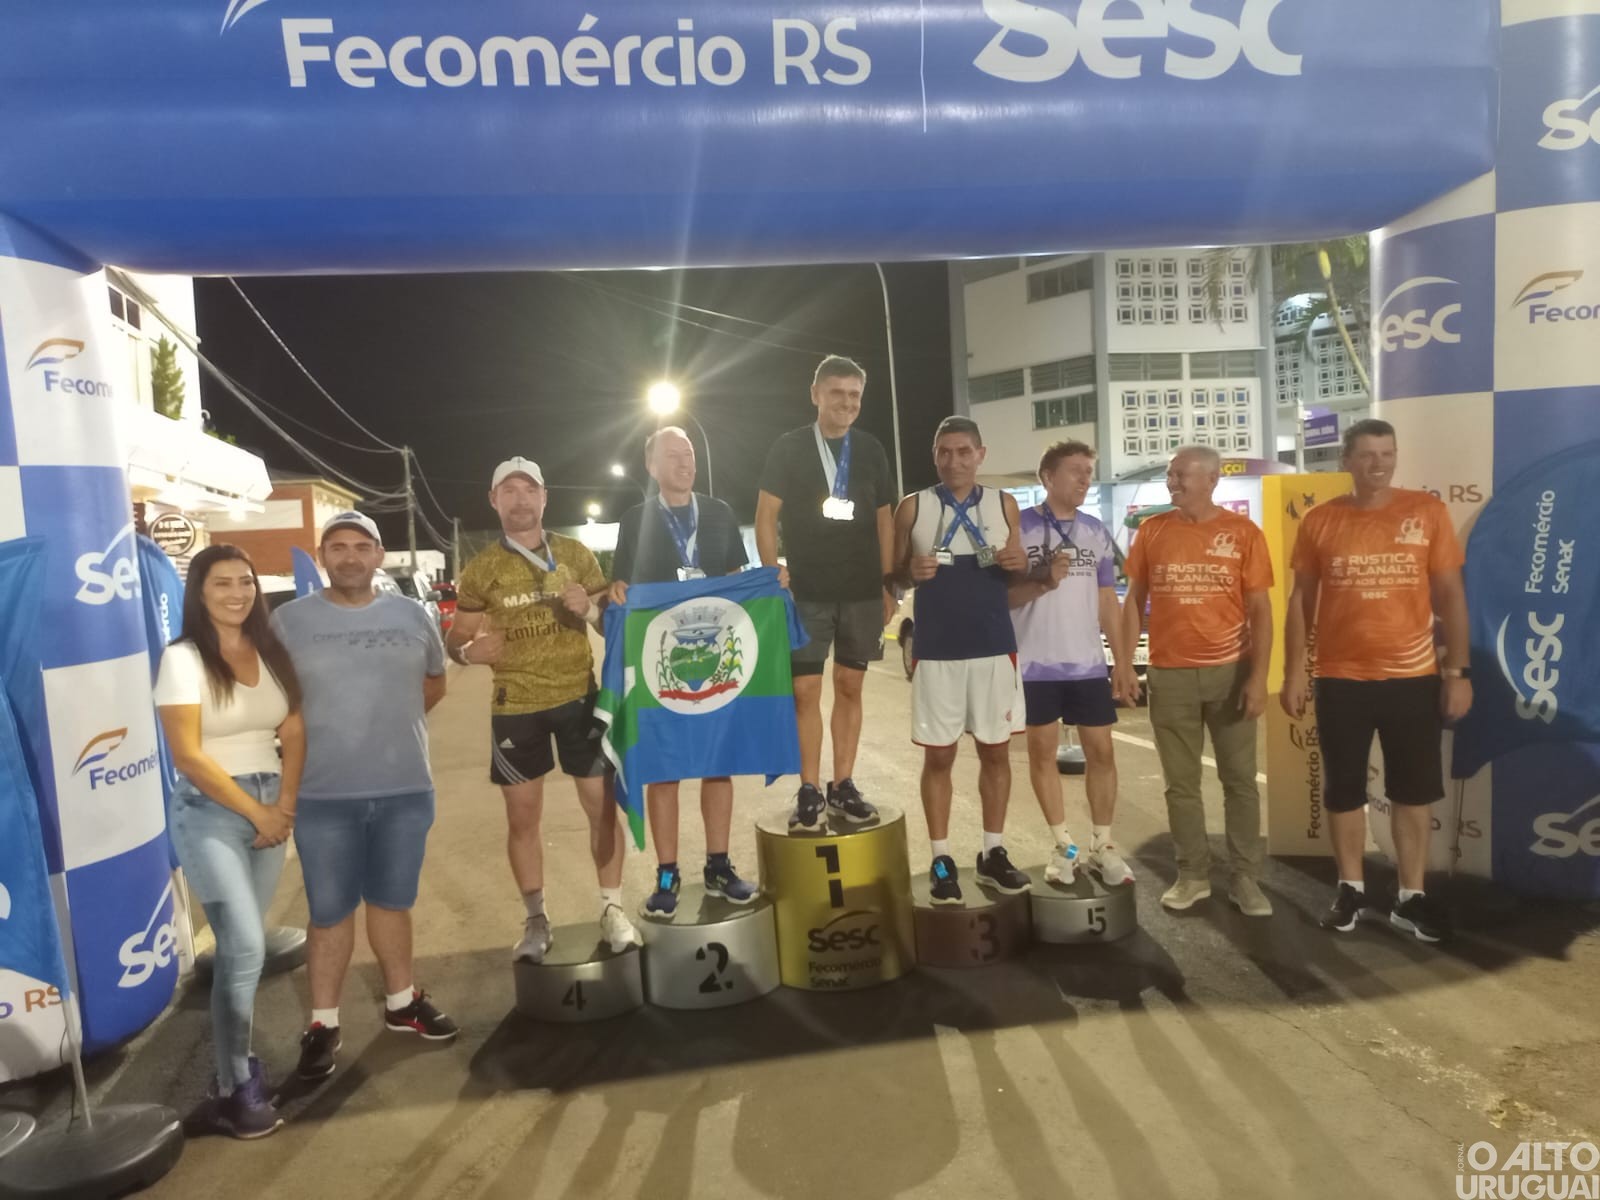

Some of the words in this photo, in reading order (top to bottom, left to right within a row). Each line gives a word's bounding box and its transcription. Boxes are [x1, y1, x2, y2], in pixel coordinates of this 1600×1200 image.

[280, 14, 746, 88] Fecomércio
[773, 15, 872, 86] RS
[1448, 483, 1484, 504] RS
[1525, 489, 1556, 594] Fecomércio
[1552, 538, 1576, 595] Senac
[1305, 751, 1322, 841] Fecomércio
[815, 844, 845, 908] 1
[970, 913, 1000, 961] 3
[1087, 906, 1108, 936] 5
[561, 979, 588, 1011] 4
